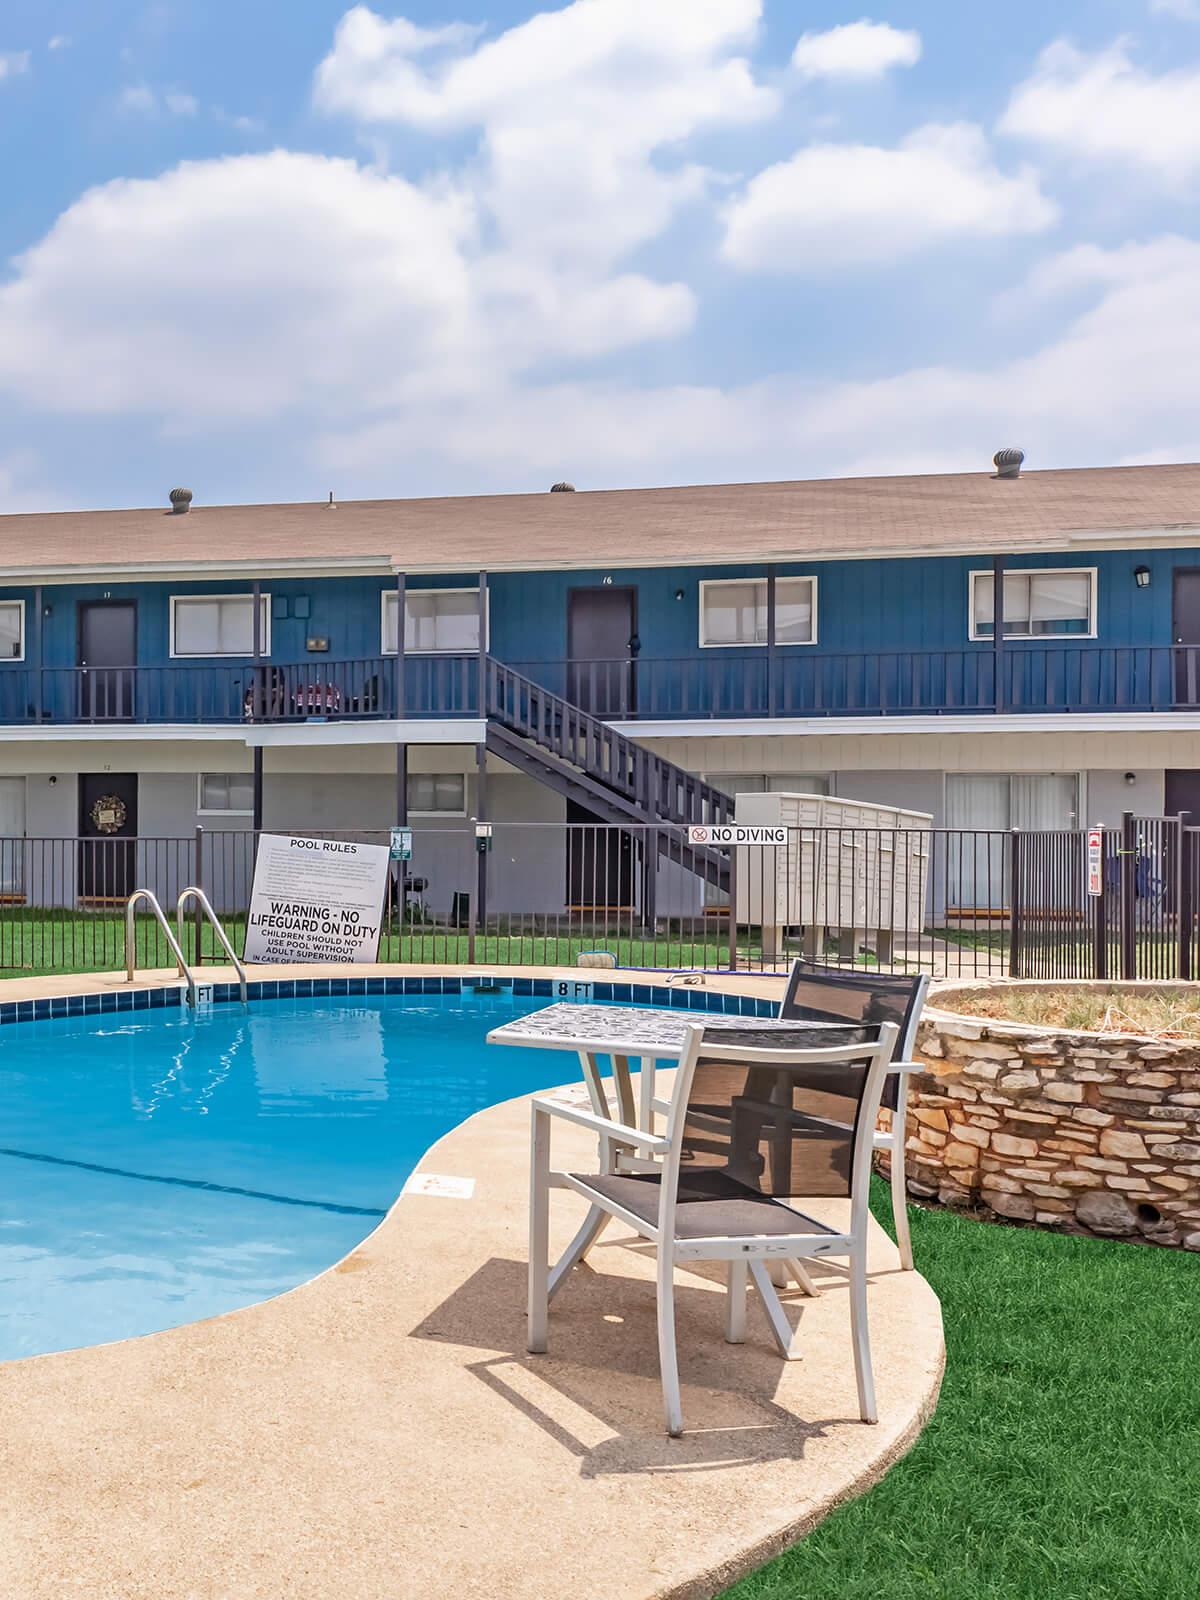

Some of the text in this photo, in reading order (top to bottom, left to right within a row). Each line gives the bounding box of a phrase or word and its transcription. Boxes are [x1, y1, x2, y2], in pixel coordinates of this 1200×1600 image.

[603, 576, 612, 585] 16
[711, 828, 784, 842] NO DIVING
[290, 839, 357, 854] POOL RULES
[271, 902, 330, 920] WARNING
[341, 911, 360, 923] NO
[251, 913, 377, 939] LIFEGUARD ON DUTY
[261, 929, 363, 947] CHILDREN SHOULD NOT
[265, 946, 355, 963] ADULT SUPERVISION
[268, 938, 355, 955] USE POOL WITHOUT
[198, 986, 212, 1002] FT
[558, 982, 591, 998] 8 FT
